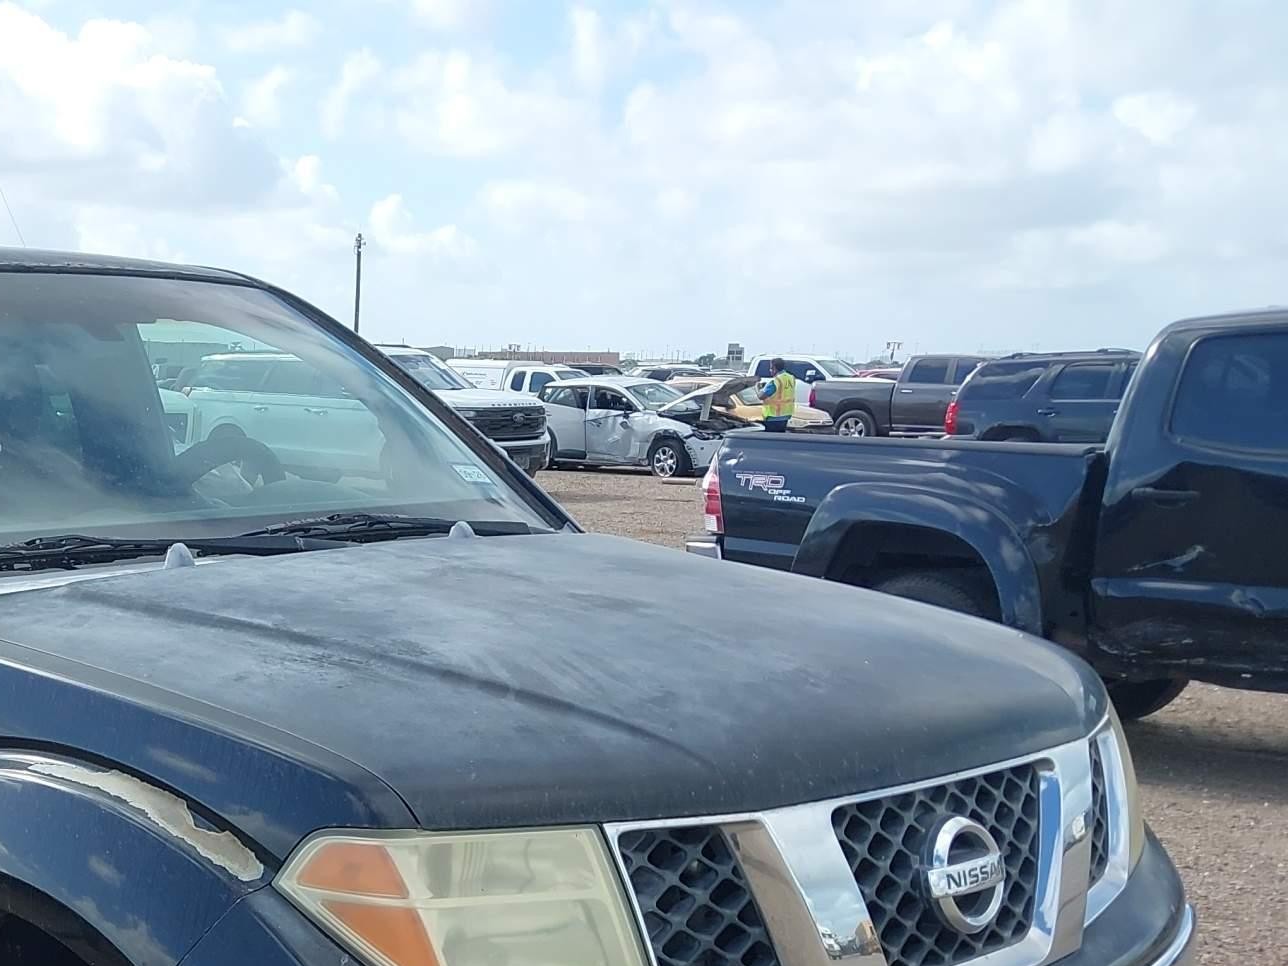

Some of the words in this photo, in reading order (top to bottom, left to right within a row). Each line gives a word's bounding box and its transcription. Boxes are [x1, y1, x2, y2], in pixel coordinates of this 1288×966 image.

[735, 473, 785, 491] TRD
[773, 495, 806, 503] ROAD
[945, 856, 1004, 890] NISSAN
